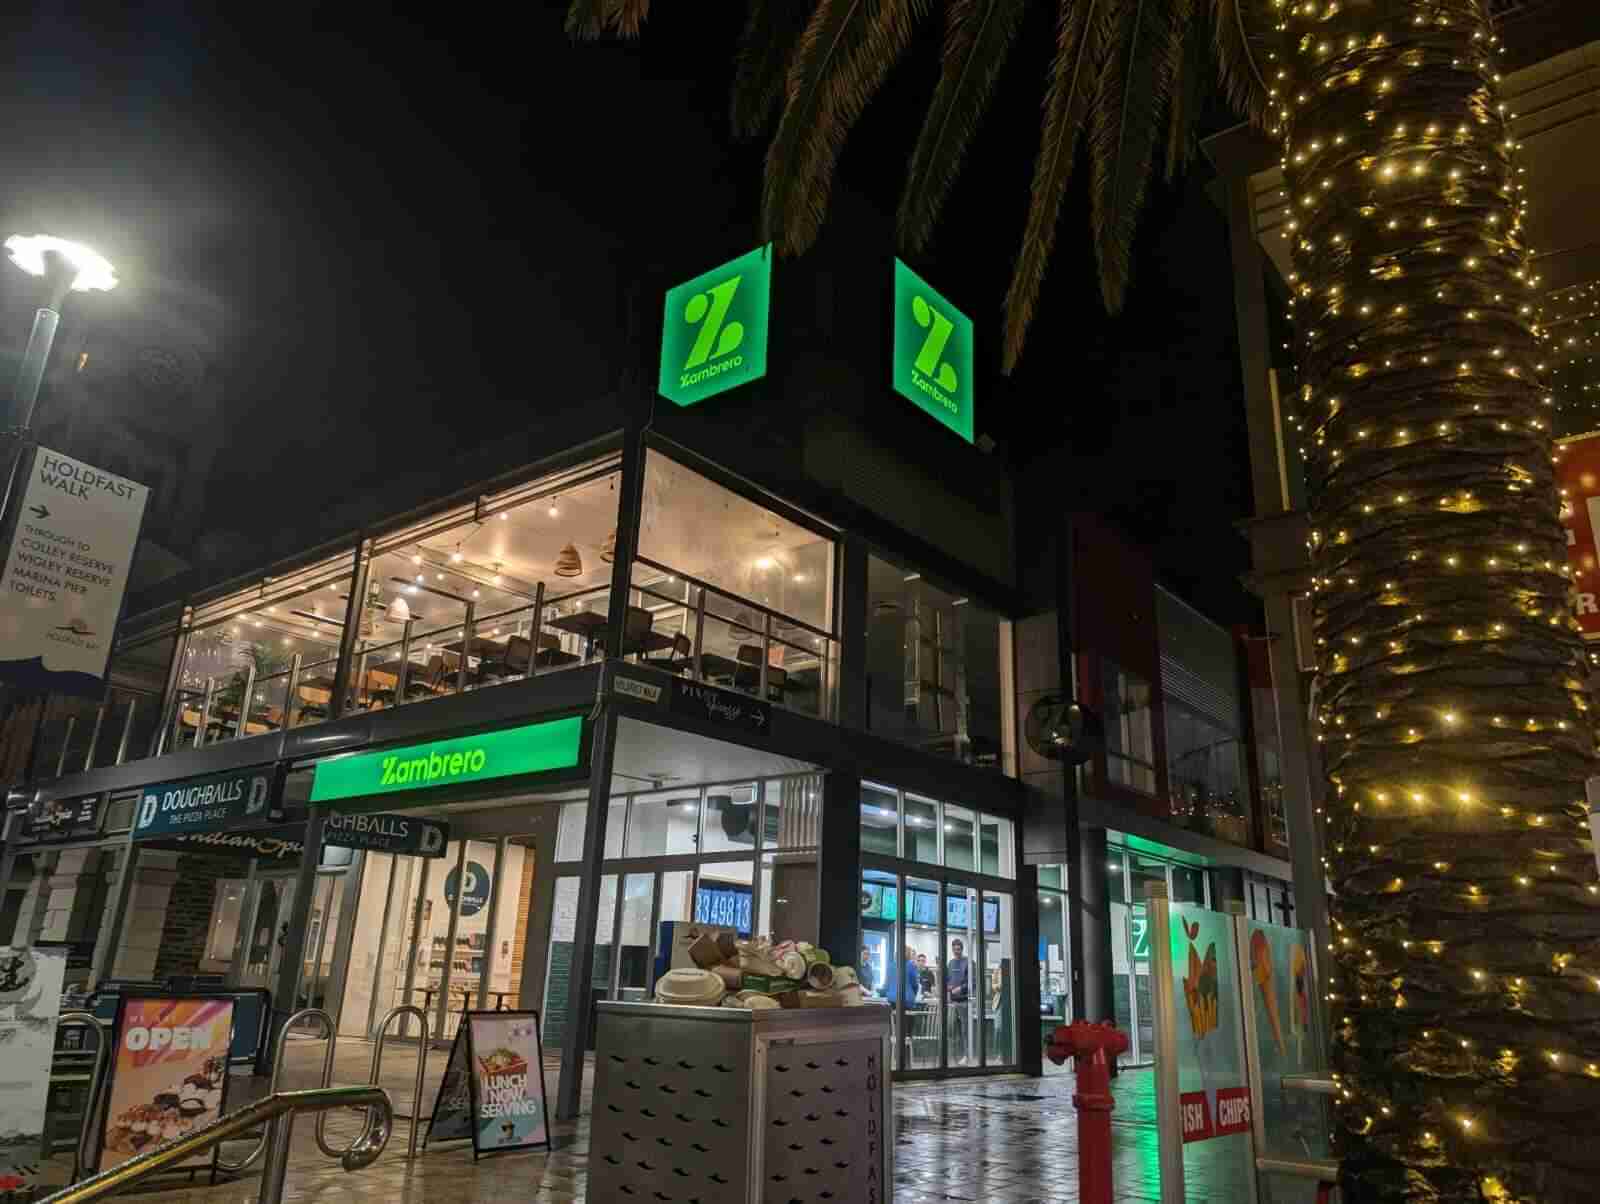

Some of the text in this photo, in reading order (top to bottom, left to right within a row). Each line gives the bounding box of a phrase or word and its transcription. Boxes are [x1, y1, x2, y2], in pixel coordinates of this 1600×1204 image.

[680, 355, 743, 389] Zambrero
[911, 369, 958, 414] Zambrero
[41, 470, 89, 500] WALK
[42, 455, 136, 500] HOLDFAST
[24, 524, 76, 545] THROUGH
[69, 552, 114, 576] RESERVE
[13, 567, 61, 588] MARINA
[64, 566, 112, 589] RESERVE
[10, 581, 57, 601] TOILETS
[381, 749, 486, 785] Zambrero
[162, 779, 245, 811] DOUGHBALLS
[206, 807, 229, 820] PLACE
[127, 1025, 210, 1052] OPEN
[485, 1073, 528, 1090] LUNCH
[488, 1088, 524, 1102] NOW
[480, 1099, 537, 1119] SERVING
